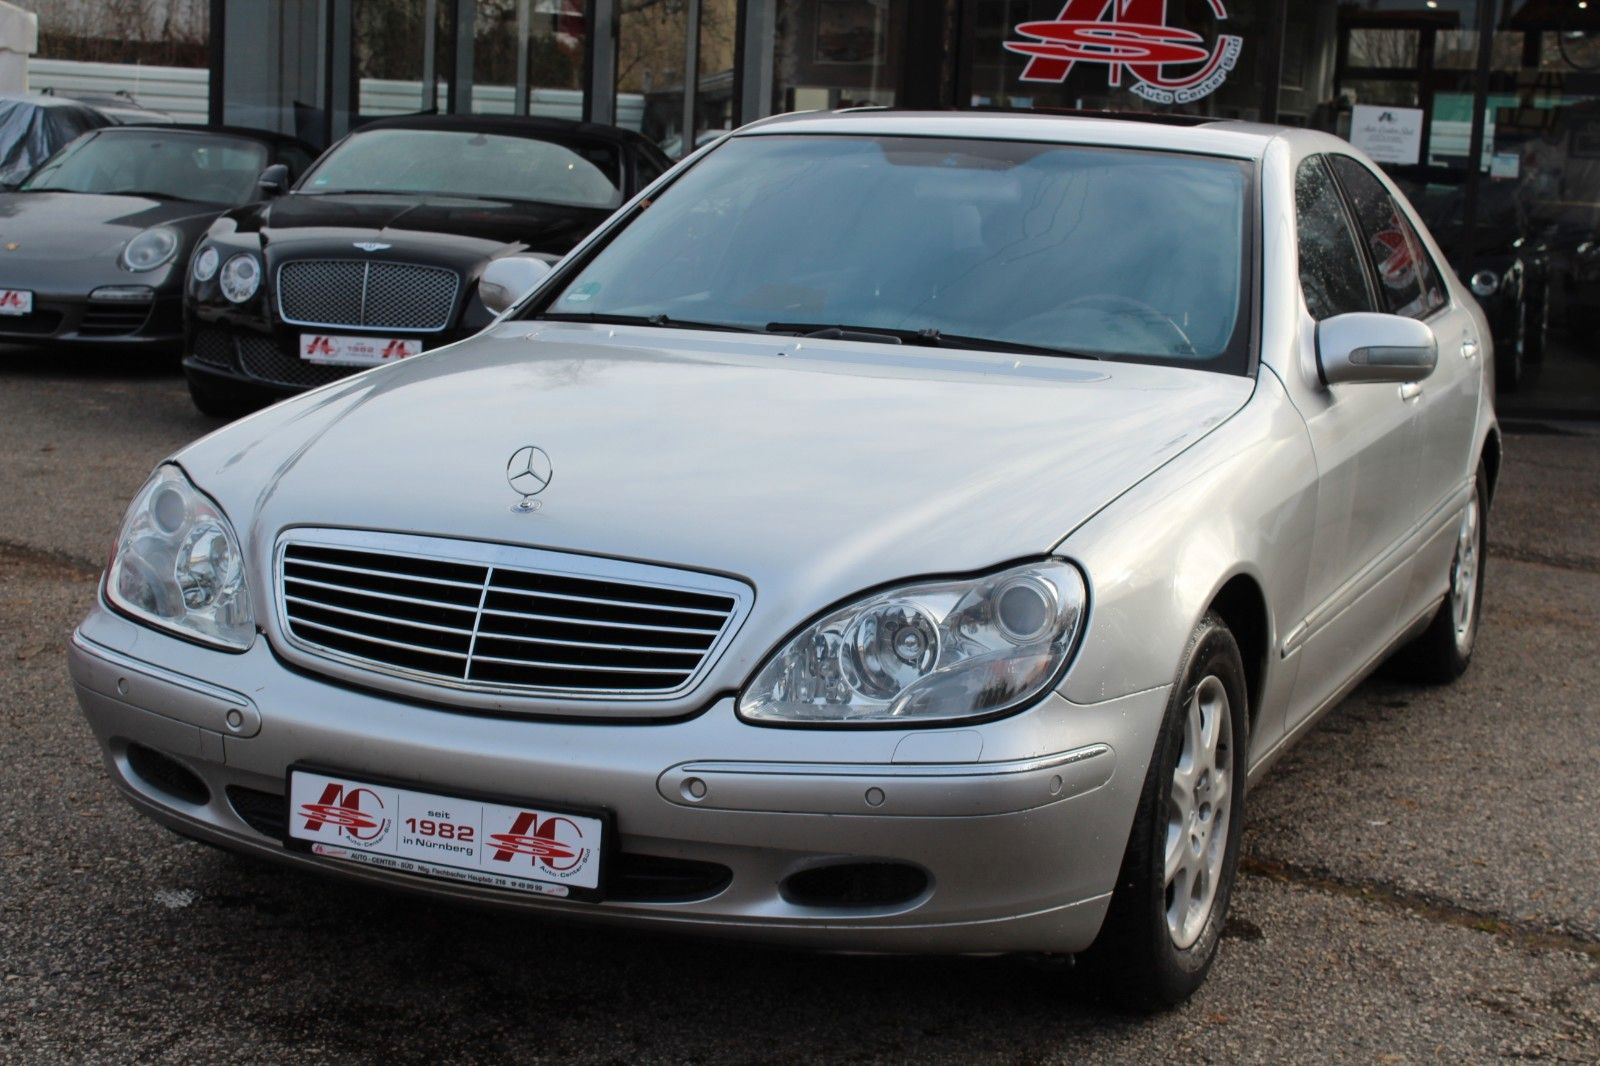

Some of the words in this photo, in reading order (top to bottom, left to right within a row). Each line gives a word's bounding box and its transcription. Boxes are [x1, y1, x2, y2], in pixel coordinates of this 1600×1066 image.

[1133, 82, 1172, 103] Auto
[1177, 68, 1226, 103] Center
[427, 810, 451, 820] seit
[405, 817, 475, 843] 1982
[403, 835, 413, 845] in
[415, 838, 474, 857] Nürnberg
[371, 856, 397, 867] CENTER
